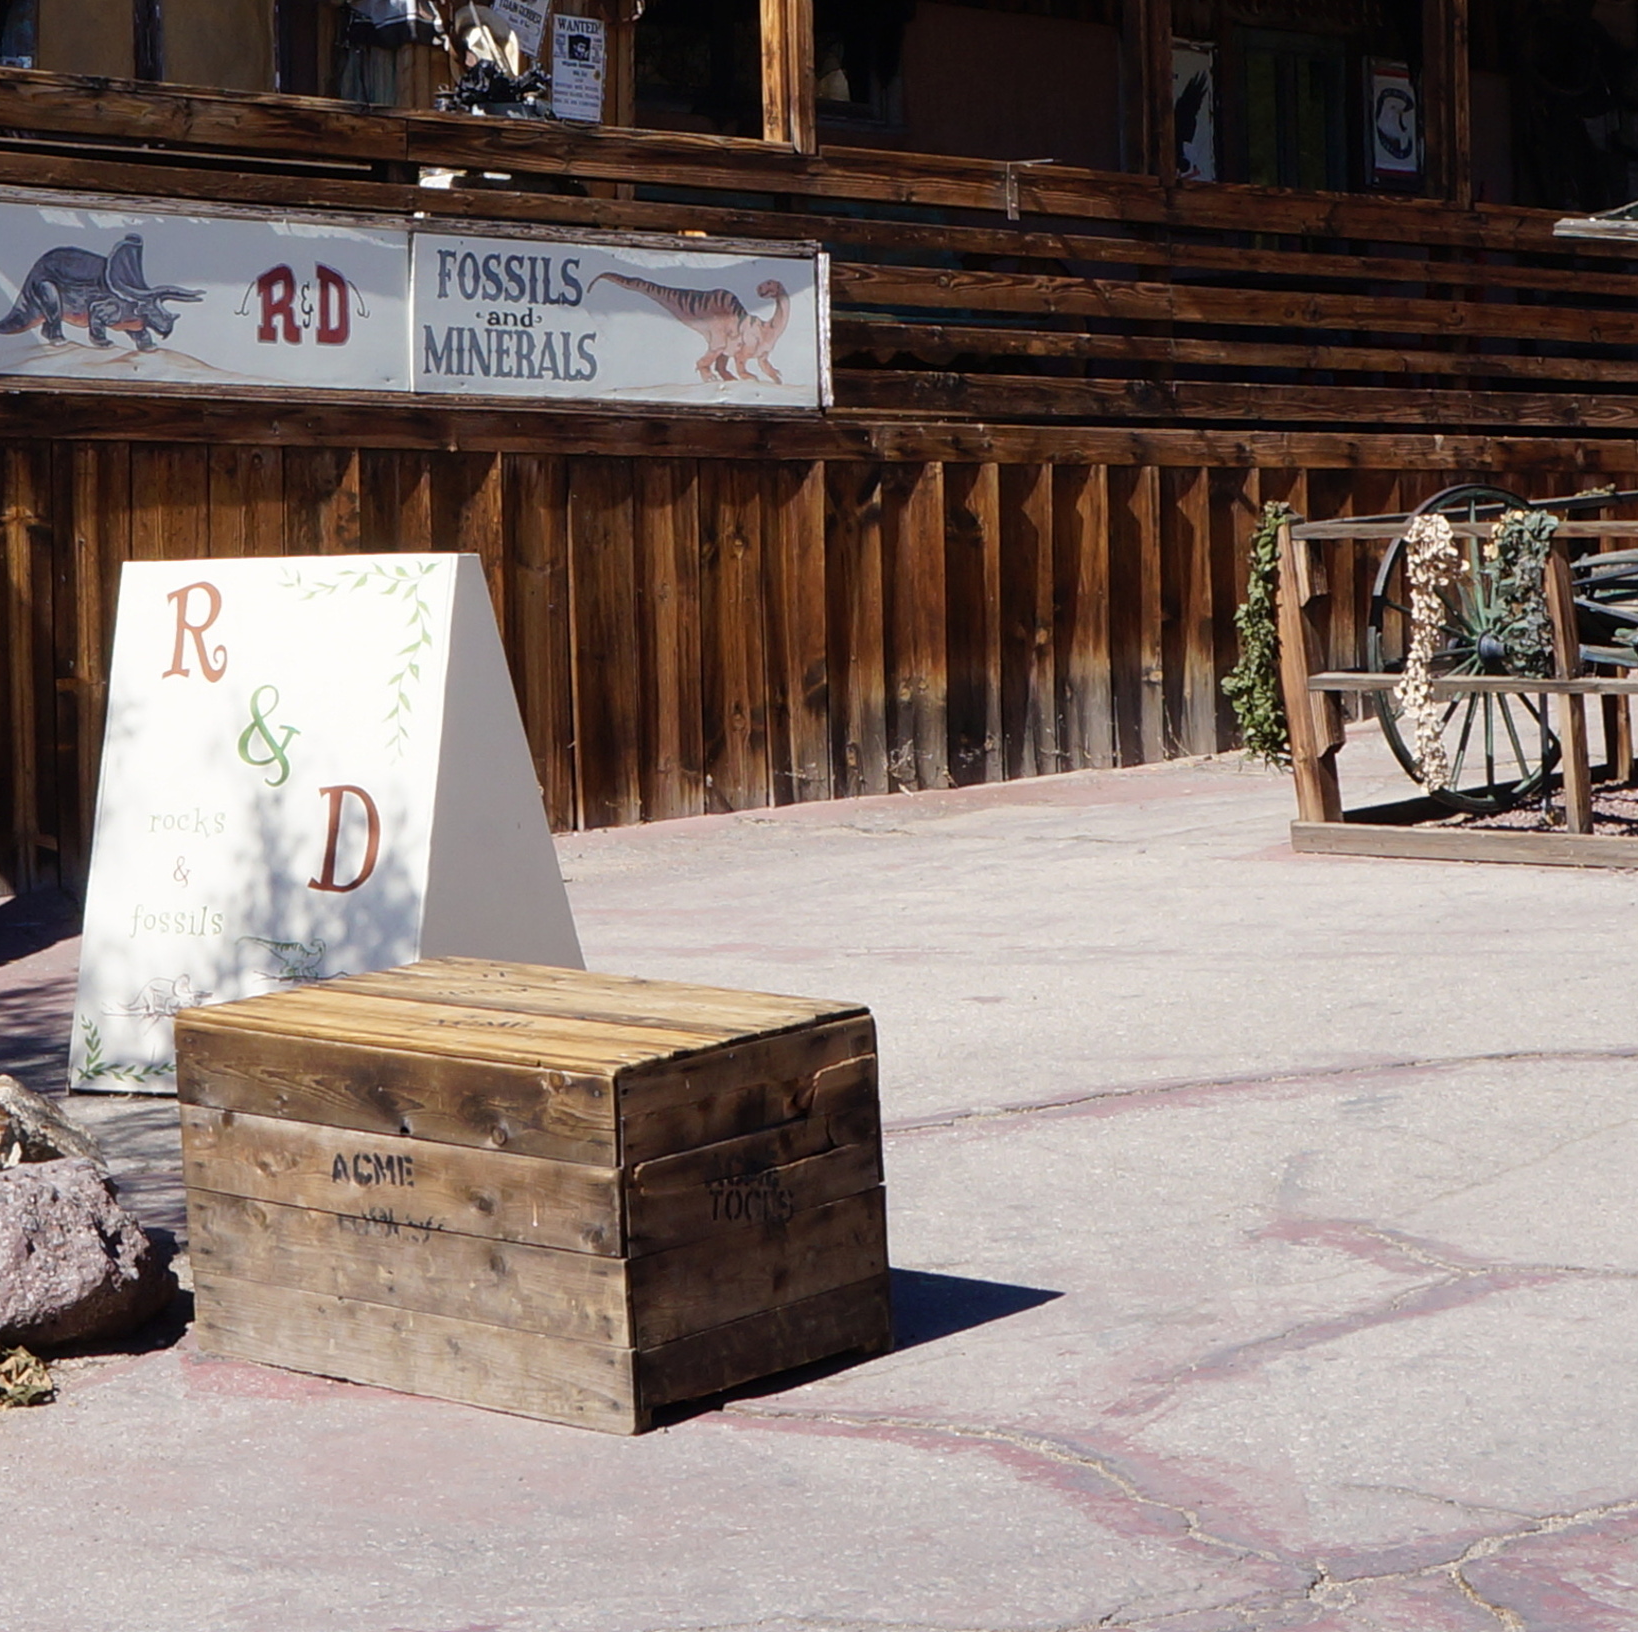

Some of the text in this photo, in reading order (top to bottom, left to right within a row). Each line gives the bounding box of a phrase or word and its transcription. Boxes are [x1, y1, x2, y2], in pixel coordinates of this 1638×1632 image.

[436, 249, 584, 308] FOSSILS
[486, 307, 536, 328] and
[423, 324, 599, 382] MINERALS
[162, 580, 229, 683] R
[237, 684, 301, 788] &
[148, 806, 226, 839] rocks
[307, 784, 381, 893] D
[172, 855, 192, 889] &
[128, 903, 224, 939] fossils
[331, 1152, 415, 1188] ACME
